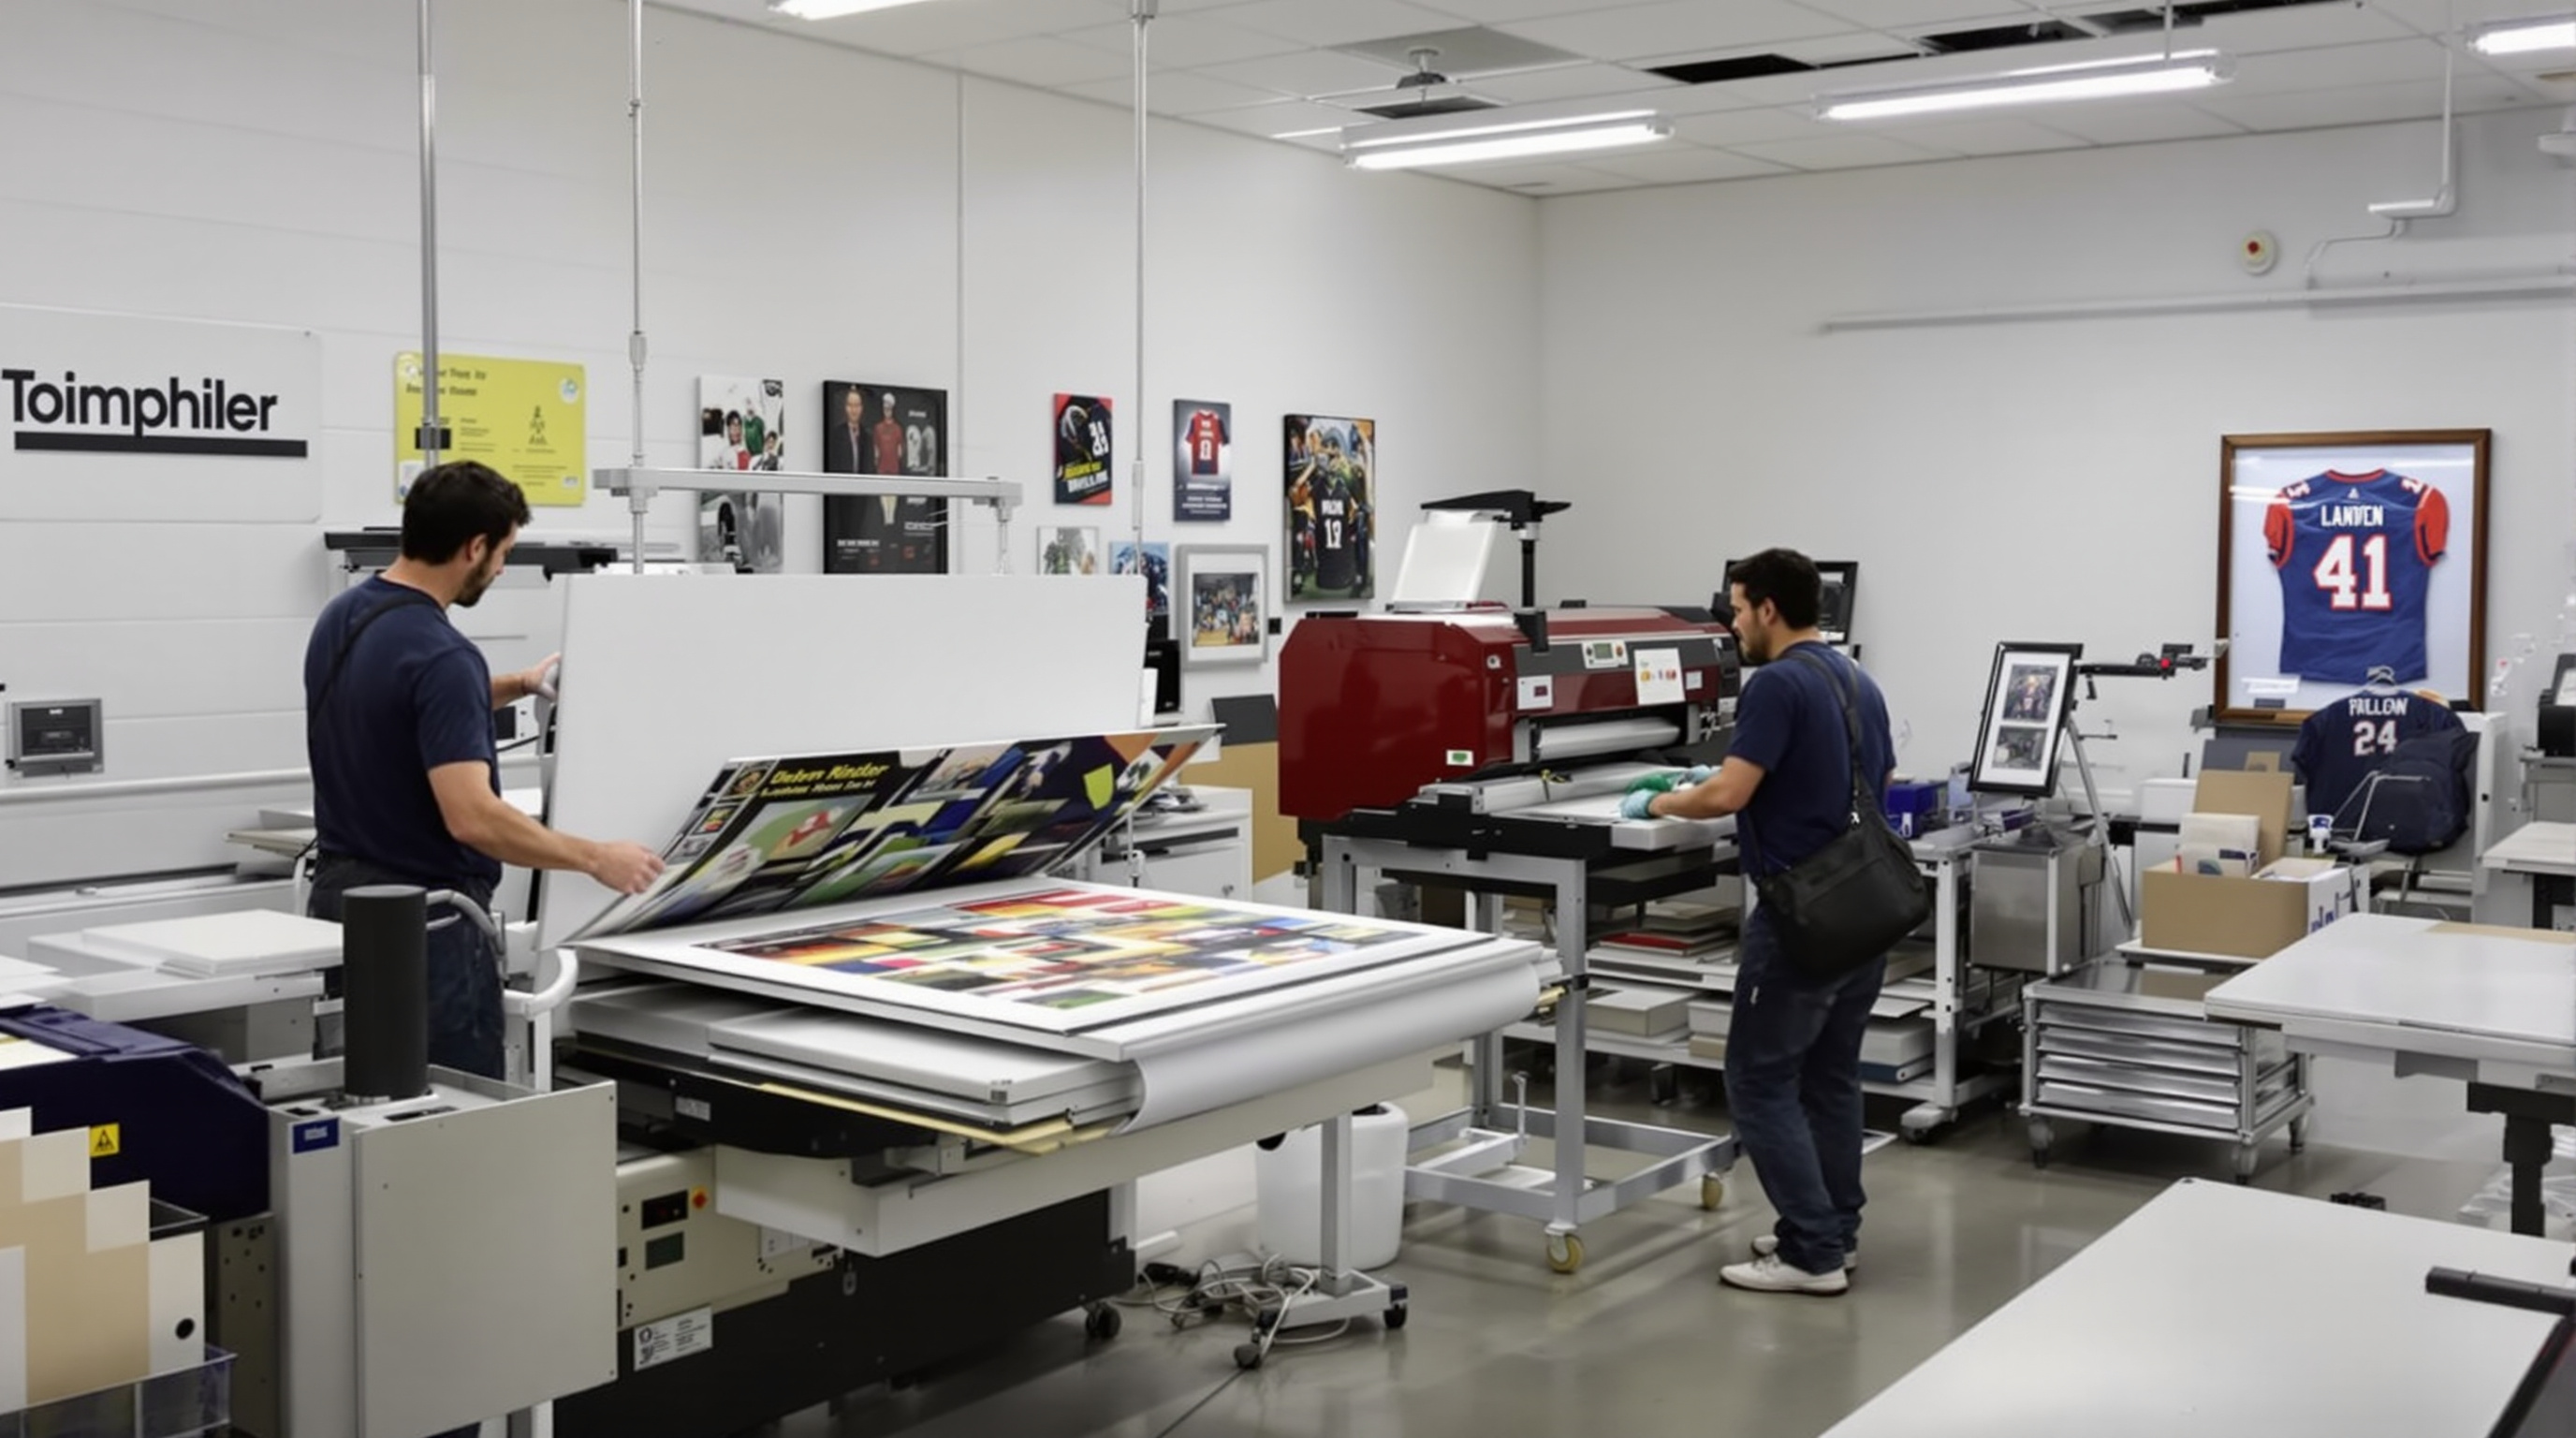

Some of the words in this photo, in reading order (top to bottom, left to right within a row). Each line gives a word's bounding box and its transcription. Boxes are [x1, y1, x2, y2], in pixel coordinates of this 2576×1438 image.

[2, 369, 278, 436] Toimphiler
[2313, 534, 2392, 609] 41
[2352, 719, 2398, 756] 24
